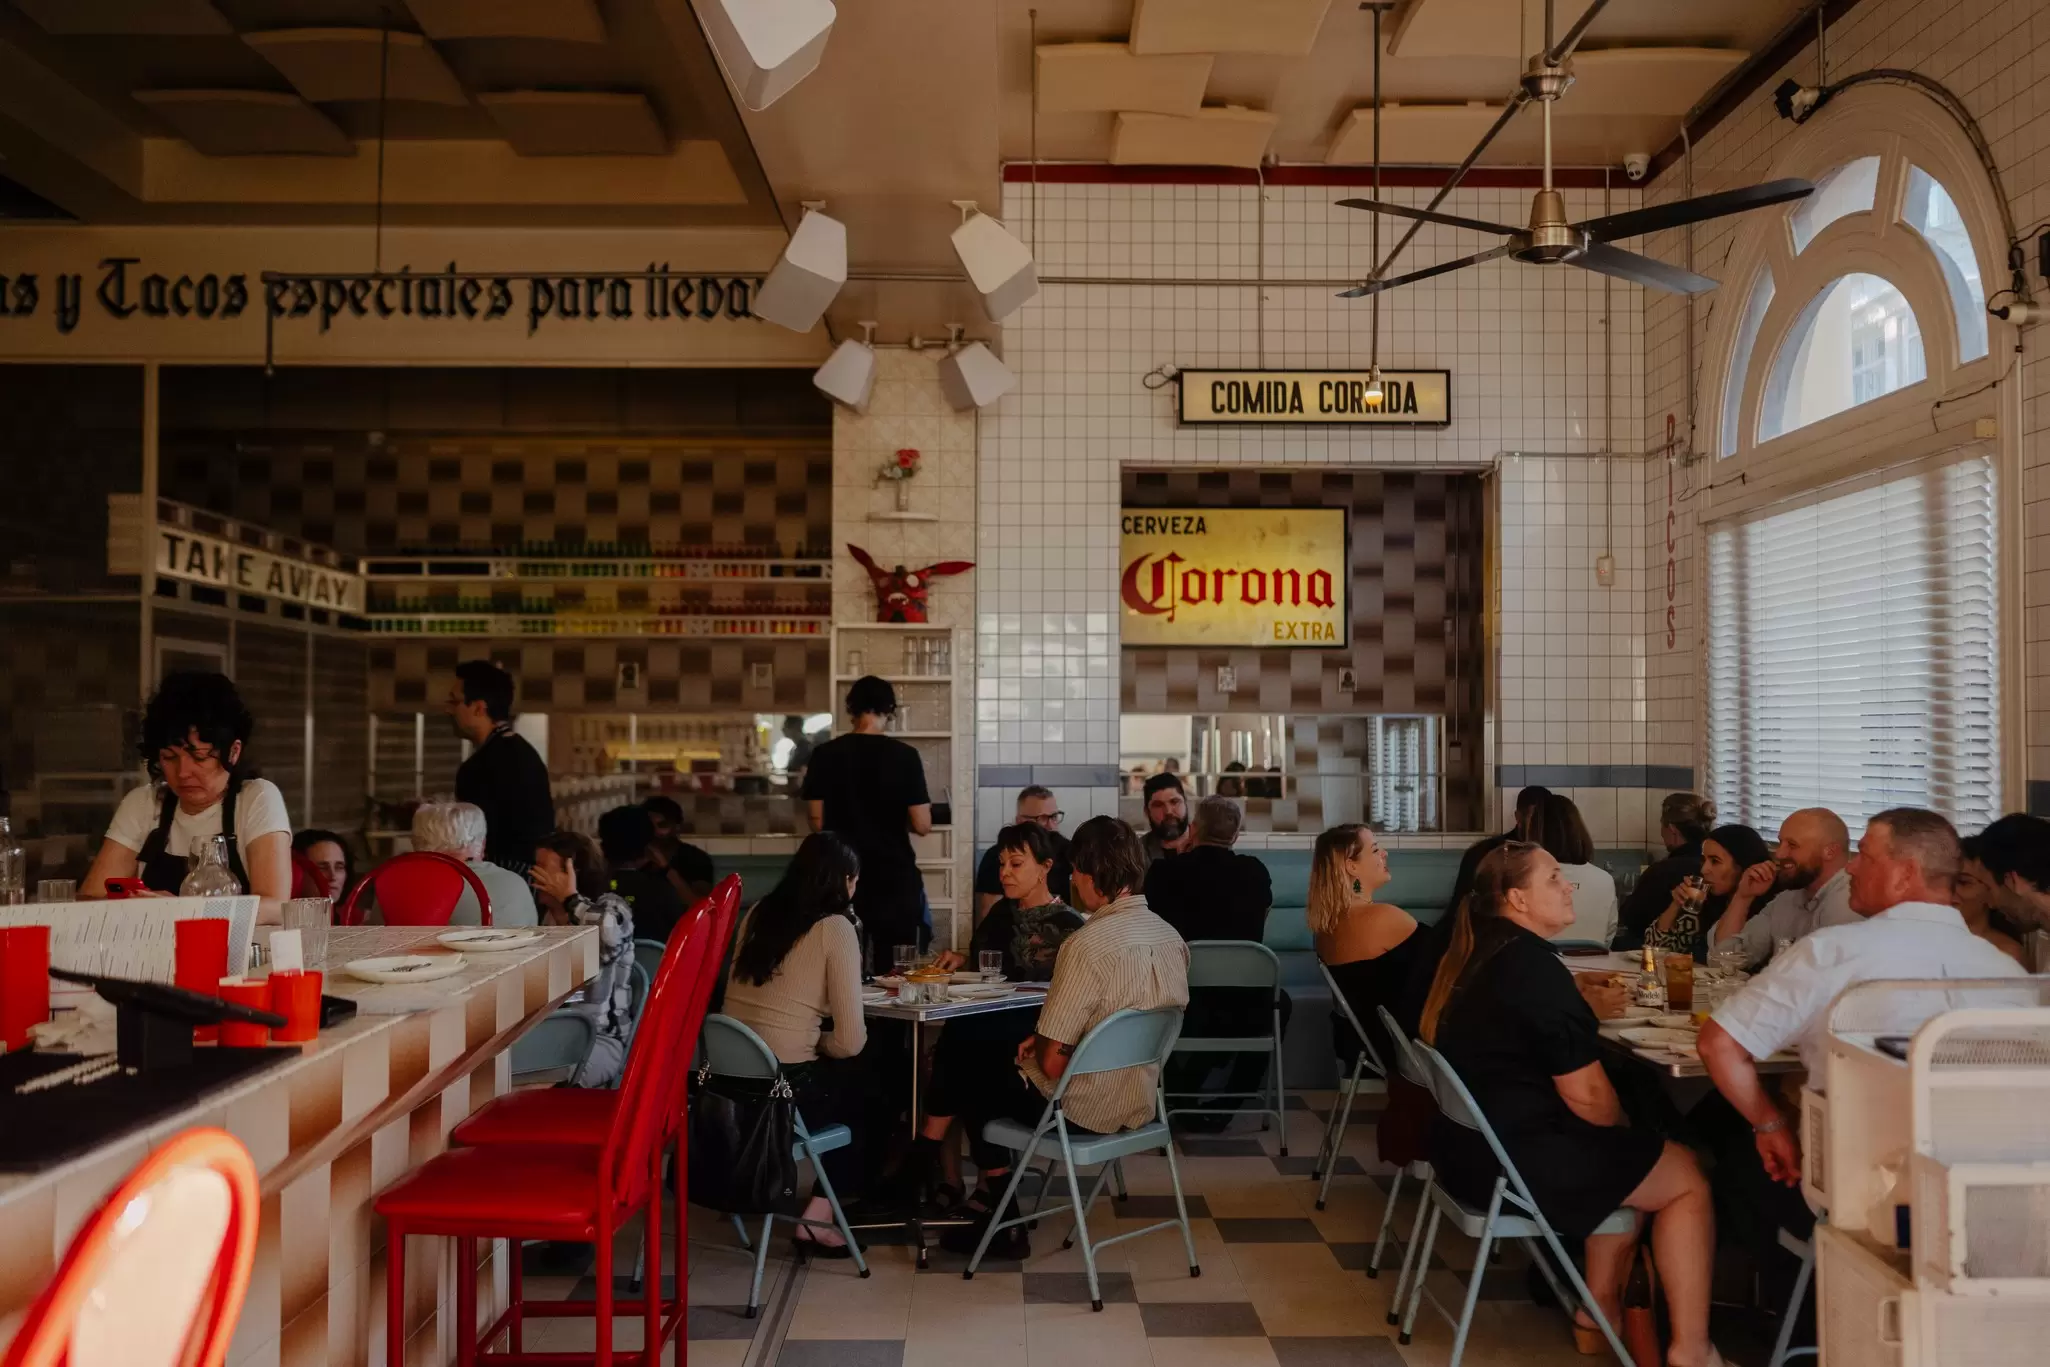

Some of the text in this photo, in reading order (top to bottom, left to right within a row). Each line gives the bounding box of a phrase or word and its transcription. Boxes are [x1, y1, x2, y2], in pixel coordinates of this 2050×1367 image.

[55, 274, 82, 334] y
[97, 257, 248, 319] Tacos
[267, 261, 513, 335] especiales
[527, 275, 633, 339] para
[644, 261, 768, 322] lleva
[1211, 380, 1304, 414] COMIDA
[1121, 516, 1207, 535] CERVEZA
[1665, 413, 1676, 650] RICOS
[267, 560, 348, 606] AWAY
[1121, 551, 1336, 624] Corona
[1273, 621, 1336, 641] EXTRA
